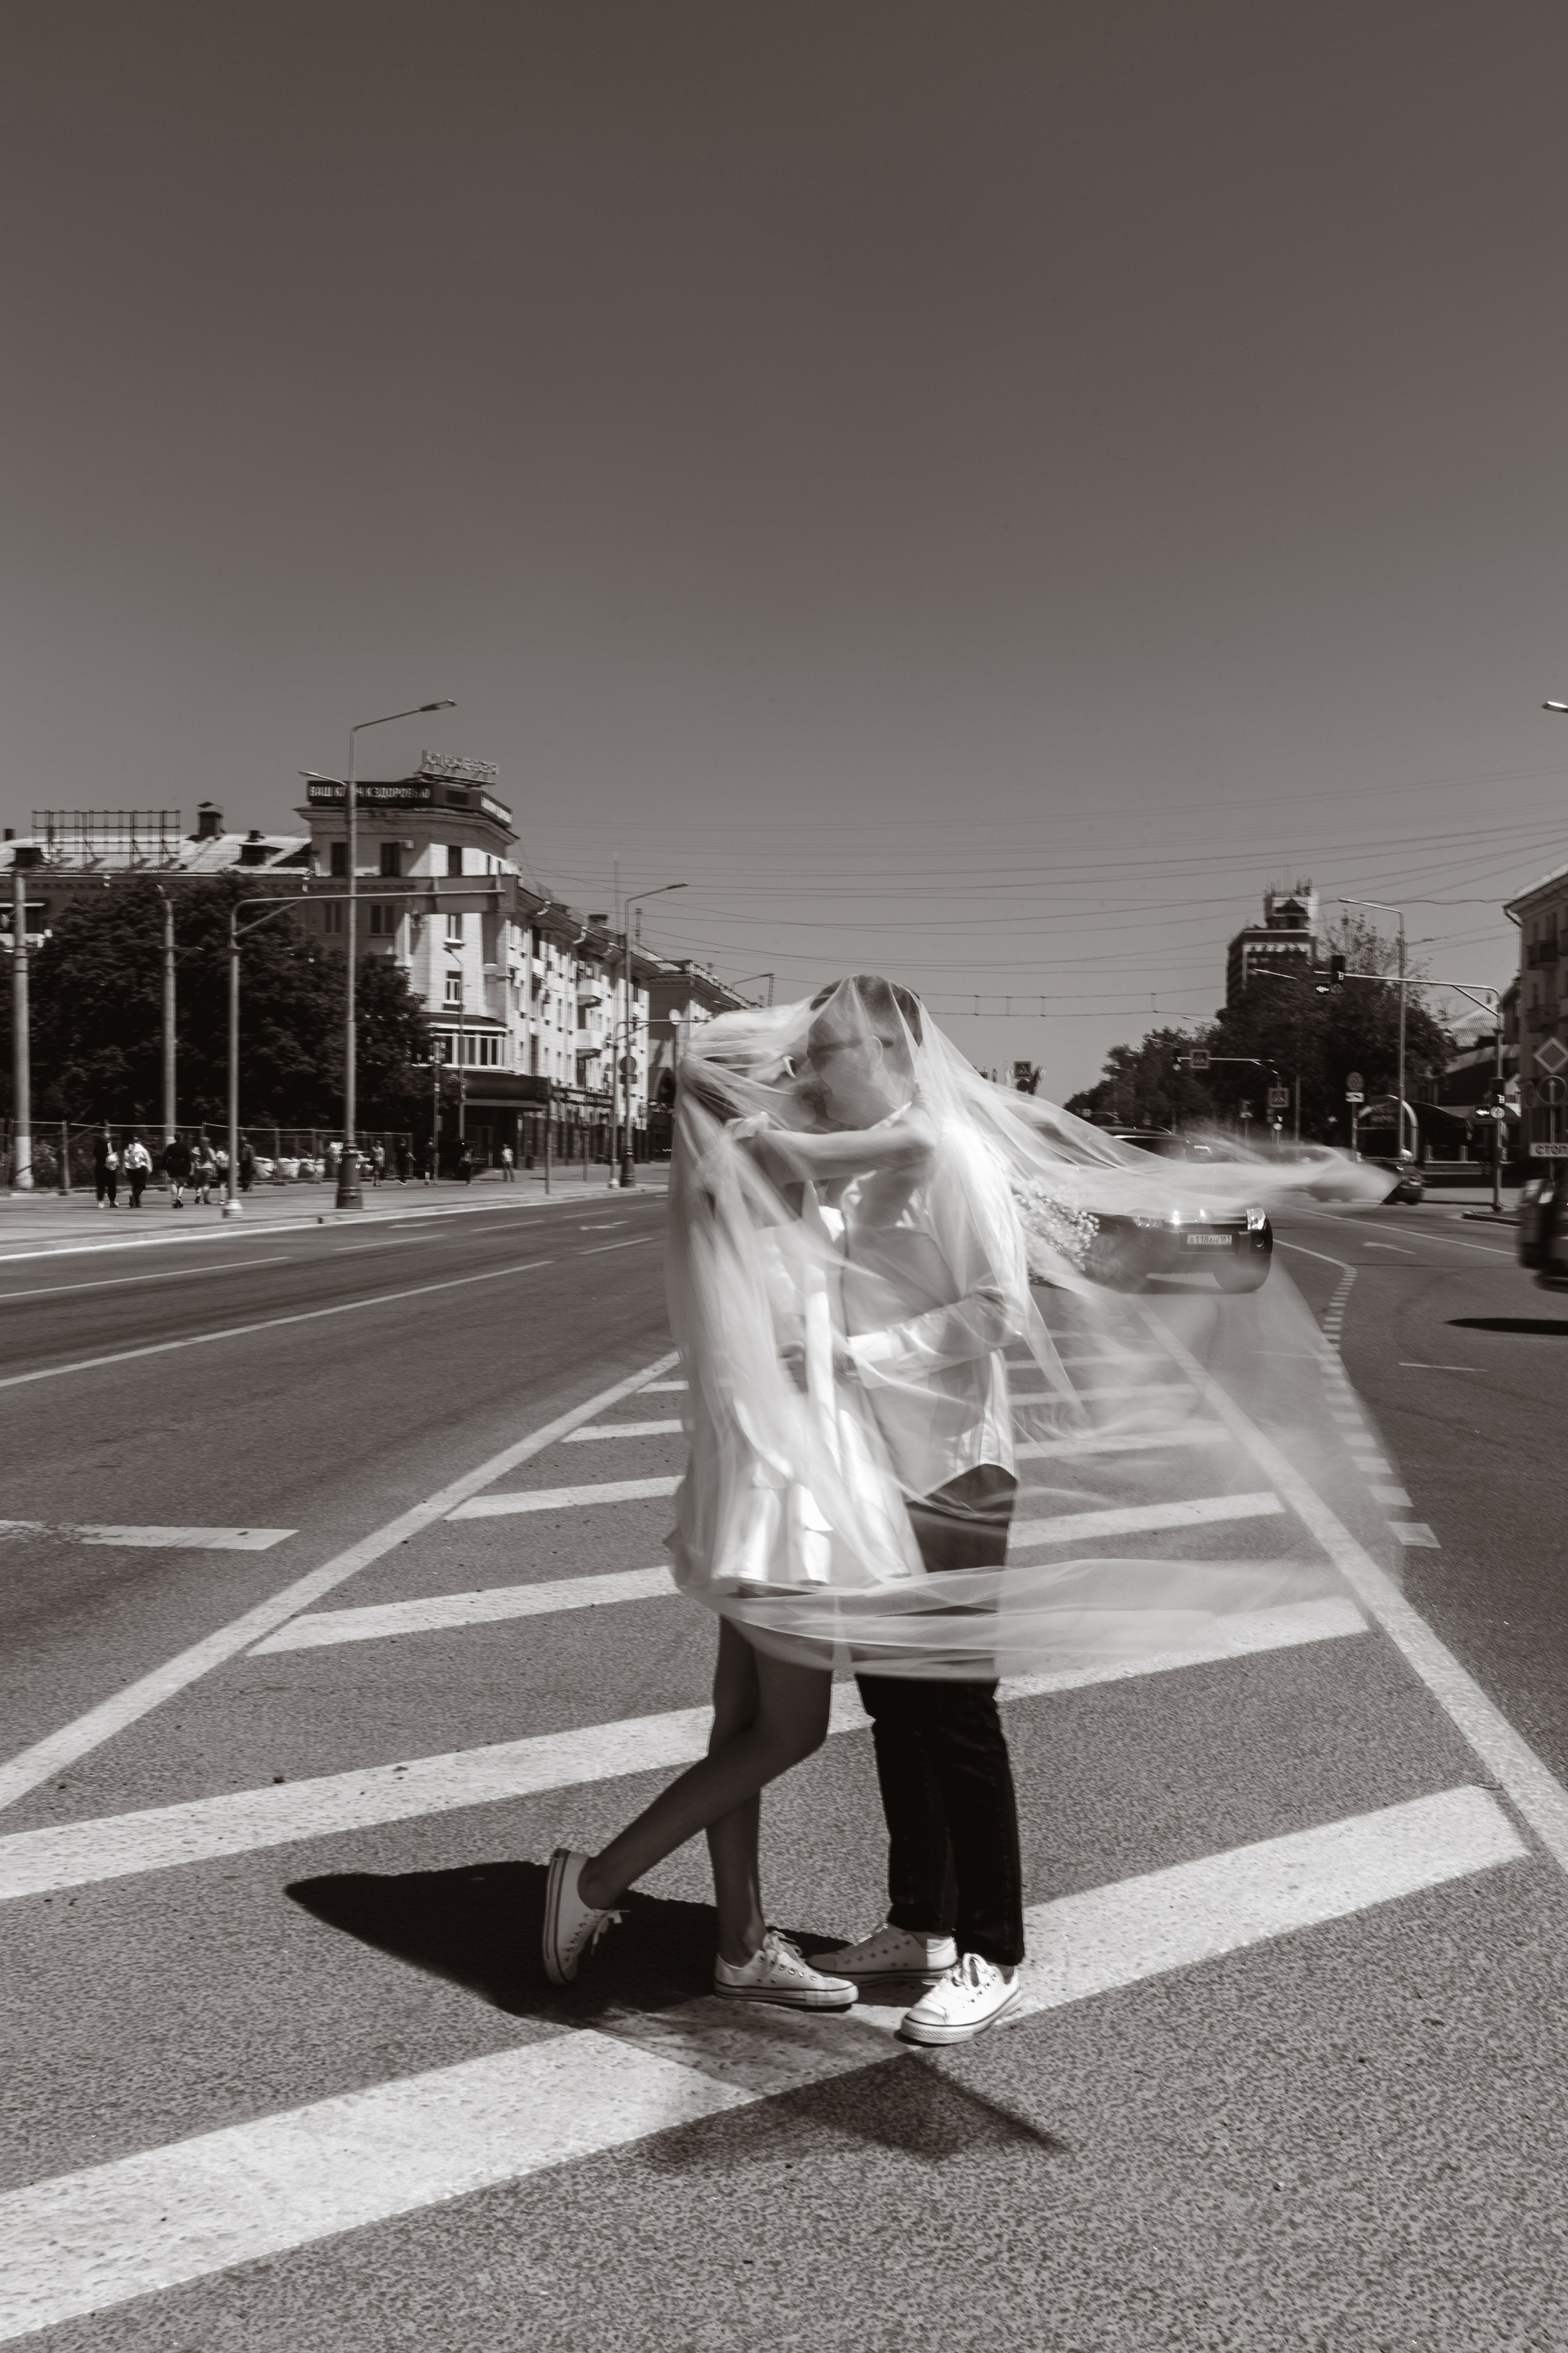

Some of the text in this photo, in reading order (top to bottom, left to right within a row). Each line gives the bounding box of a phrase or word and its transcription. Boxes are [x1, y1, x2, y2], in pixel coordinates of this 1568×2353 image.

[309, 786, 333, 796] ВАШ
[334, 786, 364, 797] КЛЧ
[372, 787, 431, 799] ЗДОРОВЬЮ
